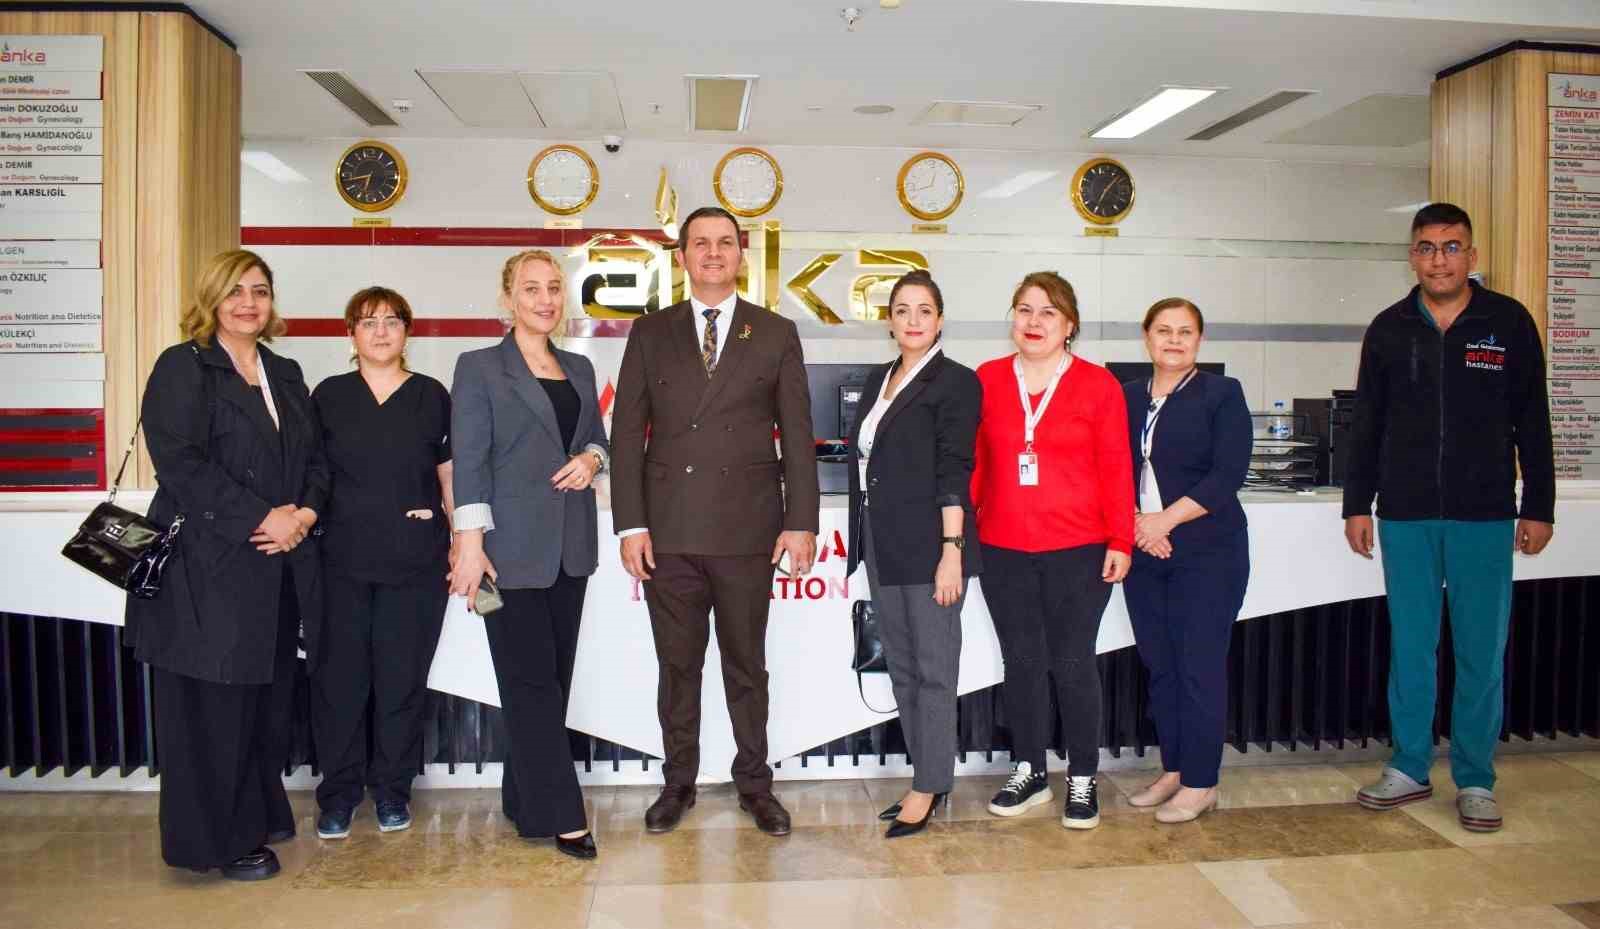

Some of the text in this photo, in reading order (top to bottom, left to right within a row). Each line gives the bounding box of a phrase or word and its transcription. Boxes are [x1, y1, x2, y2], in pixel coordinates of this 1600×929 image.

[0, 49, 46, 63] anka
[18, 104, 78, 112] DOKUZOĞLU
[37, 115, 83, 124] Gynecology
[36, 144, 82, 152] Gynecology
[5, 160, 32, 168] DEMİR
